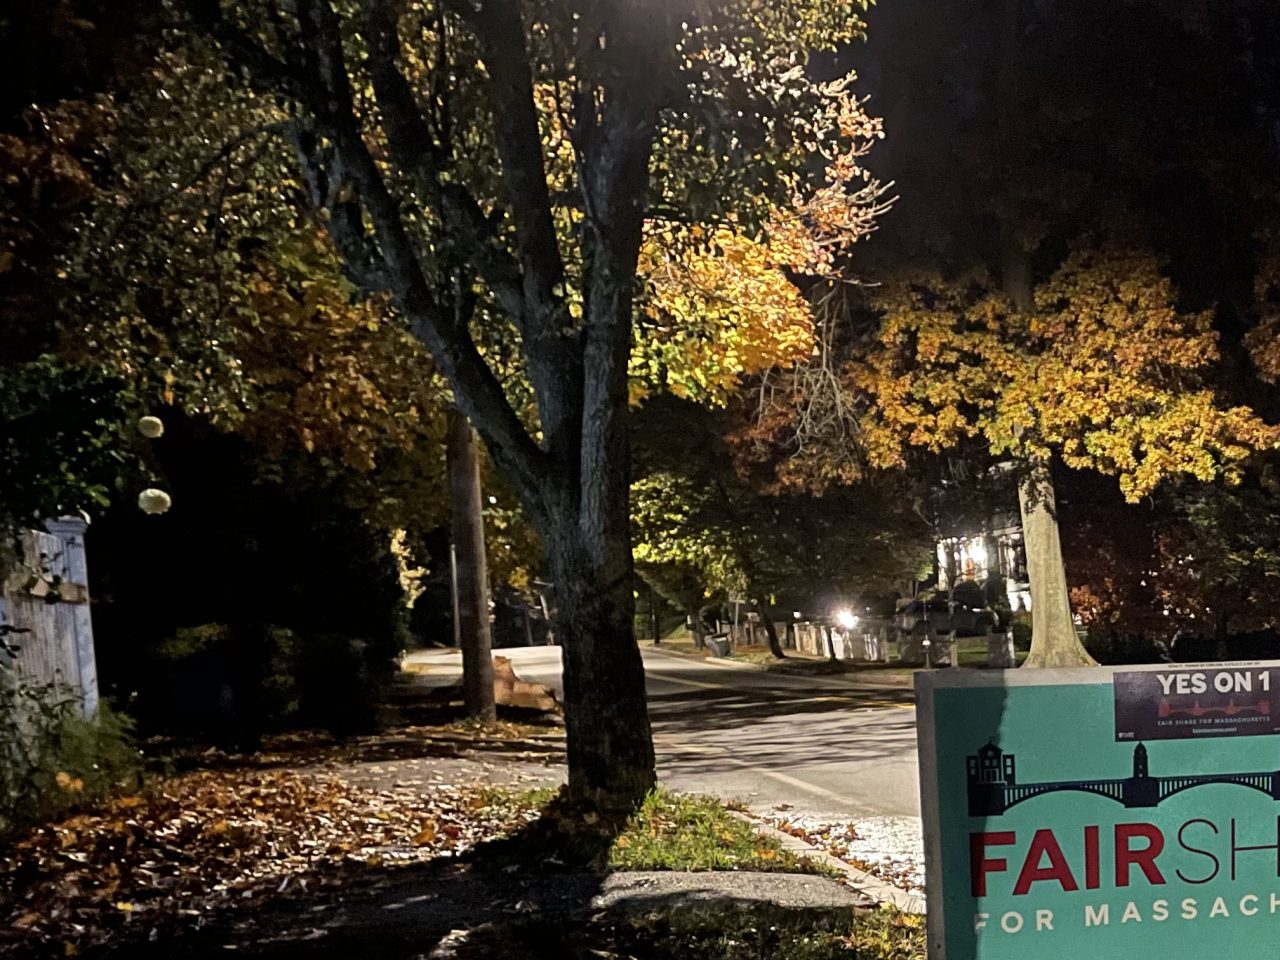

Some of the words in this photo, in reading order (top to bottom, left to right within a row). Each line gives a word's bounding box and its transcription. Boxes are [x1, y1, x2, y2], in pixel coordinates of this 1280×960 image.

[1156, 671, 1207, 695] YES
[1213, 671, 1252, 694] ON
[1258, 670, 1271, 692] 1
[974, 908, 1055, 935] FOR
